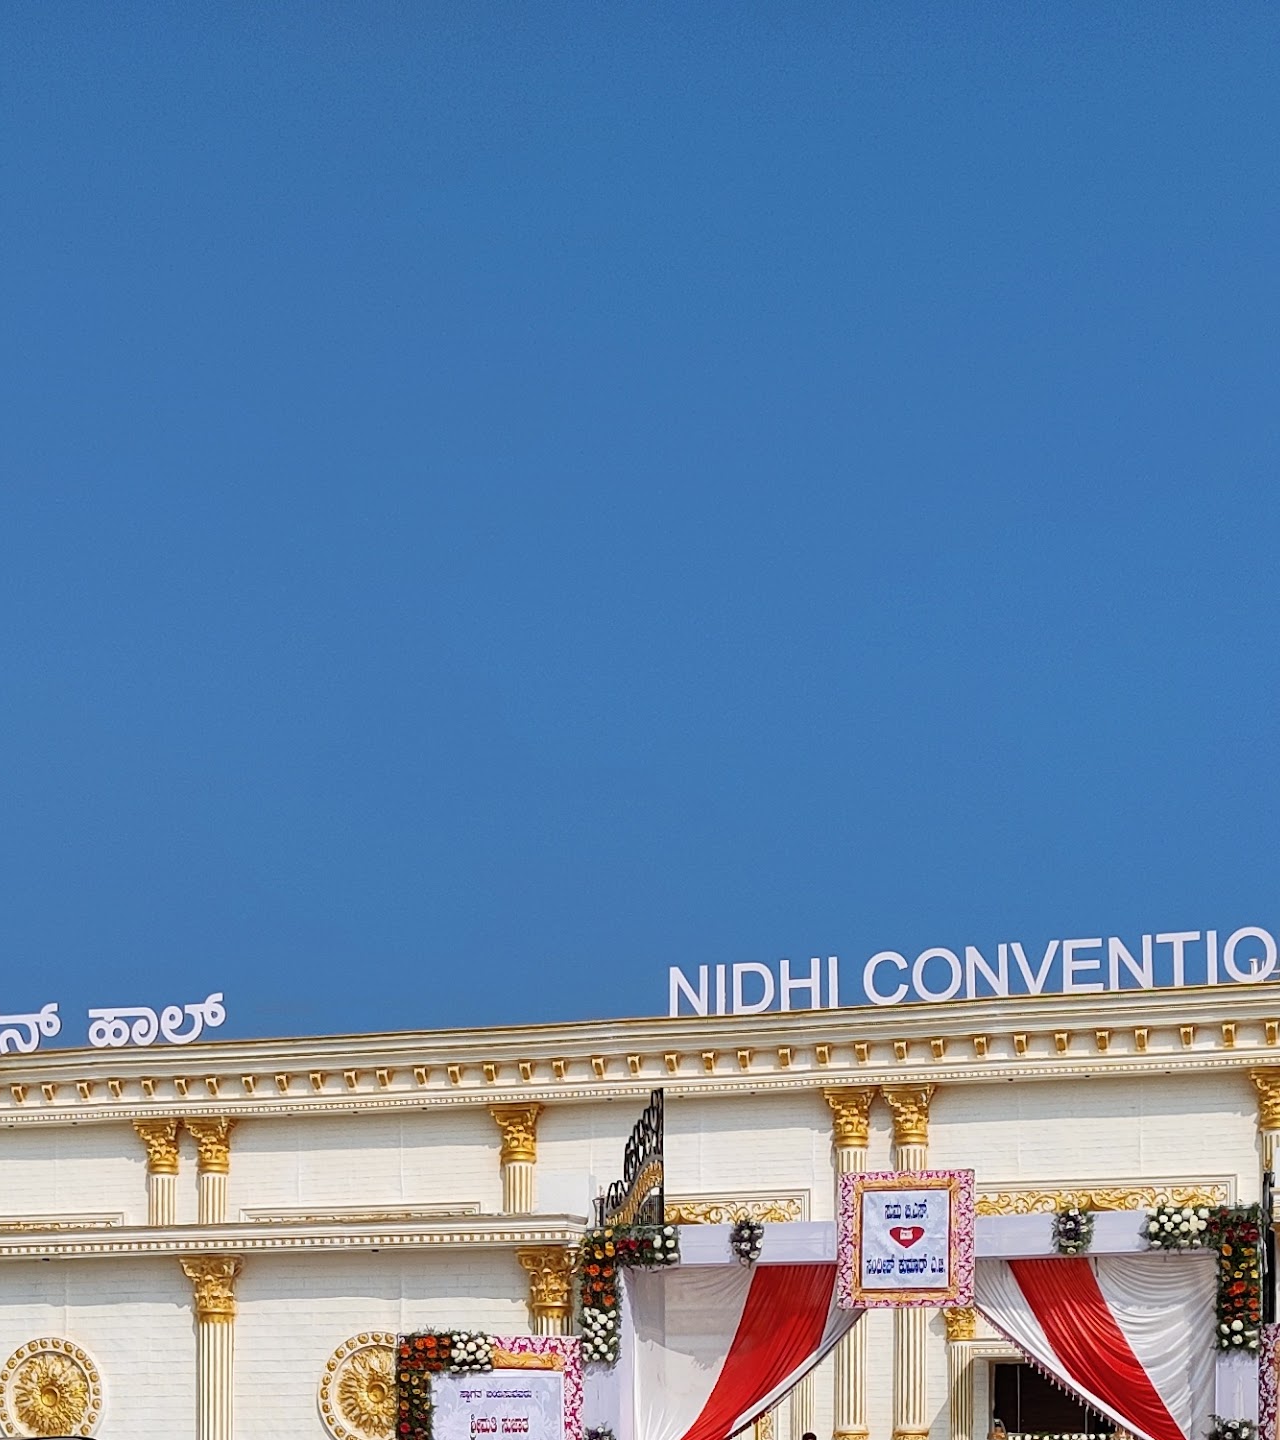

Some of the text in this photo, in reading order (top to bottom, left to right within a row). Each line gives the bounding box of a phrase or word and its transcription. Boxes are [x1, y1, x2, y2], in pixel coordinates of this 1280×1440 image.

[669, 956, 839, 1017] NIDHI
[87, 992, 227, 1047] ಹಾಲ್
[470, 1413, 498, 1440] ಶ್ರೀಮತಿ
